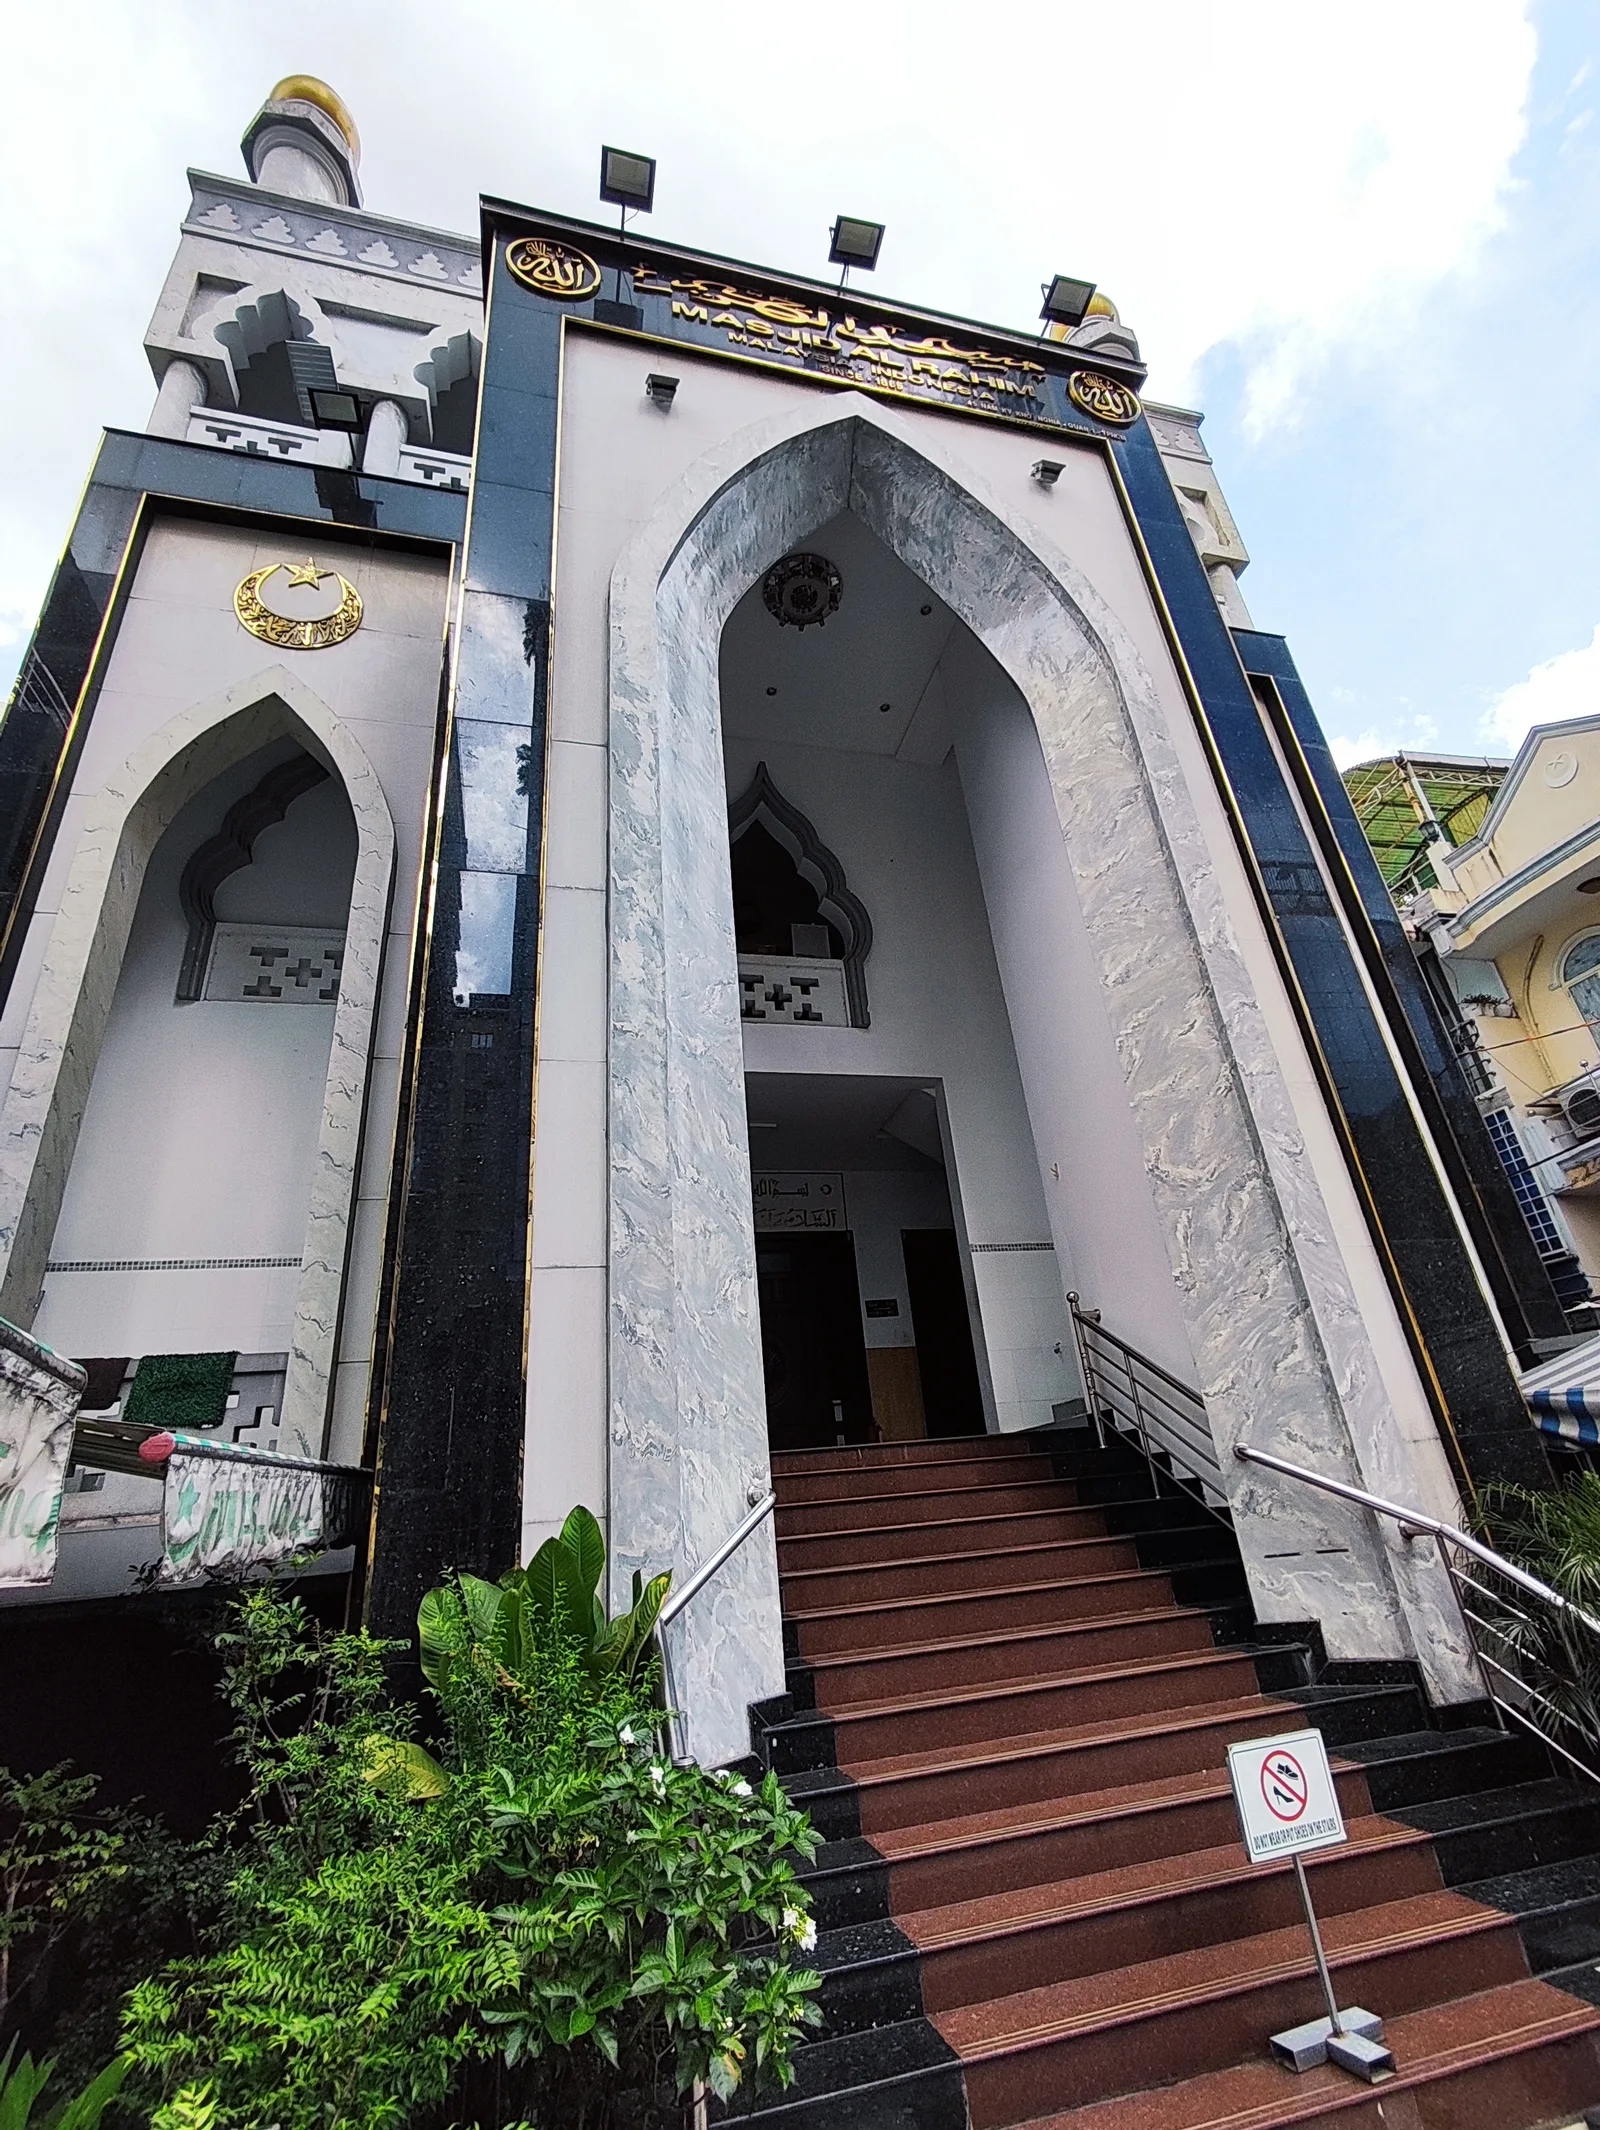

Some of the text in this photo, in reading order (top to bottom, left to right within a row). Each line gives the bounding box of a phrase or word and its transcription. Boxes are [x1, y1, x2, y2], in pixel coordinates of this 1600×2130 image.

[670, 301, 1038, 398] MASJID AL RAHIM
[728, 331, 851, 368] MALAYSIA
[870, 363, 995, 401] INDONESIA
[821, 364, 864, 381] SINCE
[980, 401, 999, 411] NAM
[1260, 1833, 1269, 1848] NOT
[1268, 1830, 1280, 1846] WEAR
[1294, 1823, 1308, 1840] SHOES
[1313, 1820, 1322, 1835] THE
[1321, 1817, 1337, 1833] STAIRS
